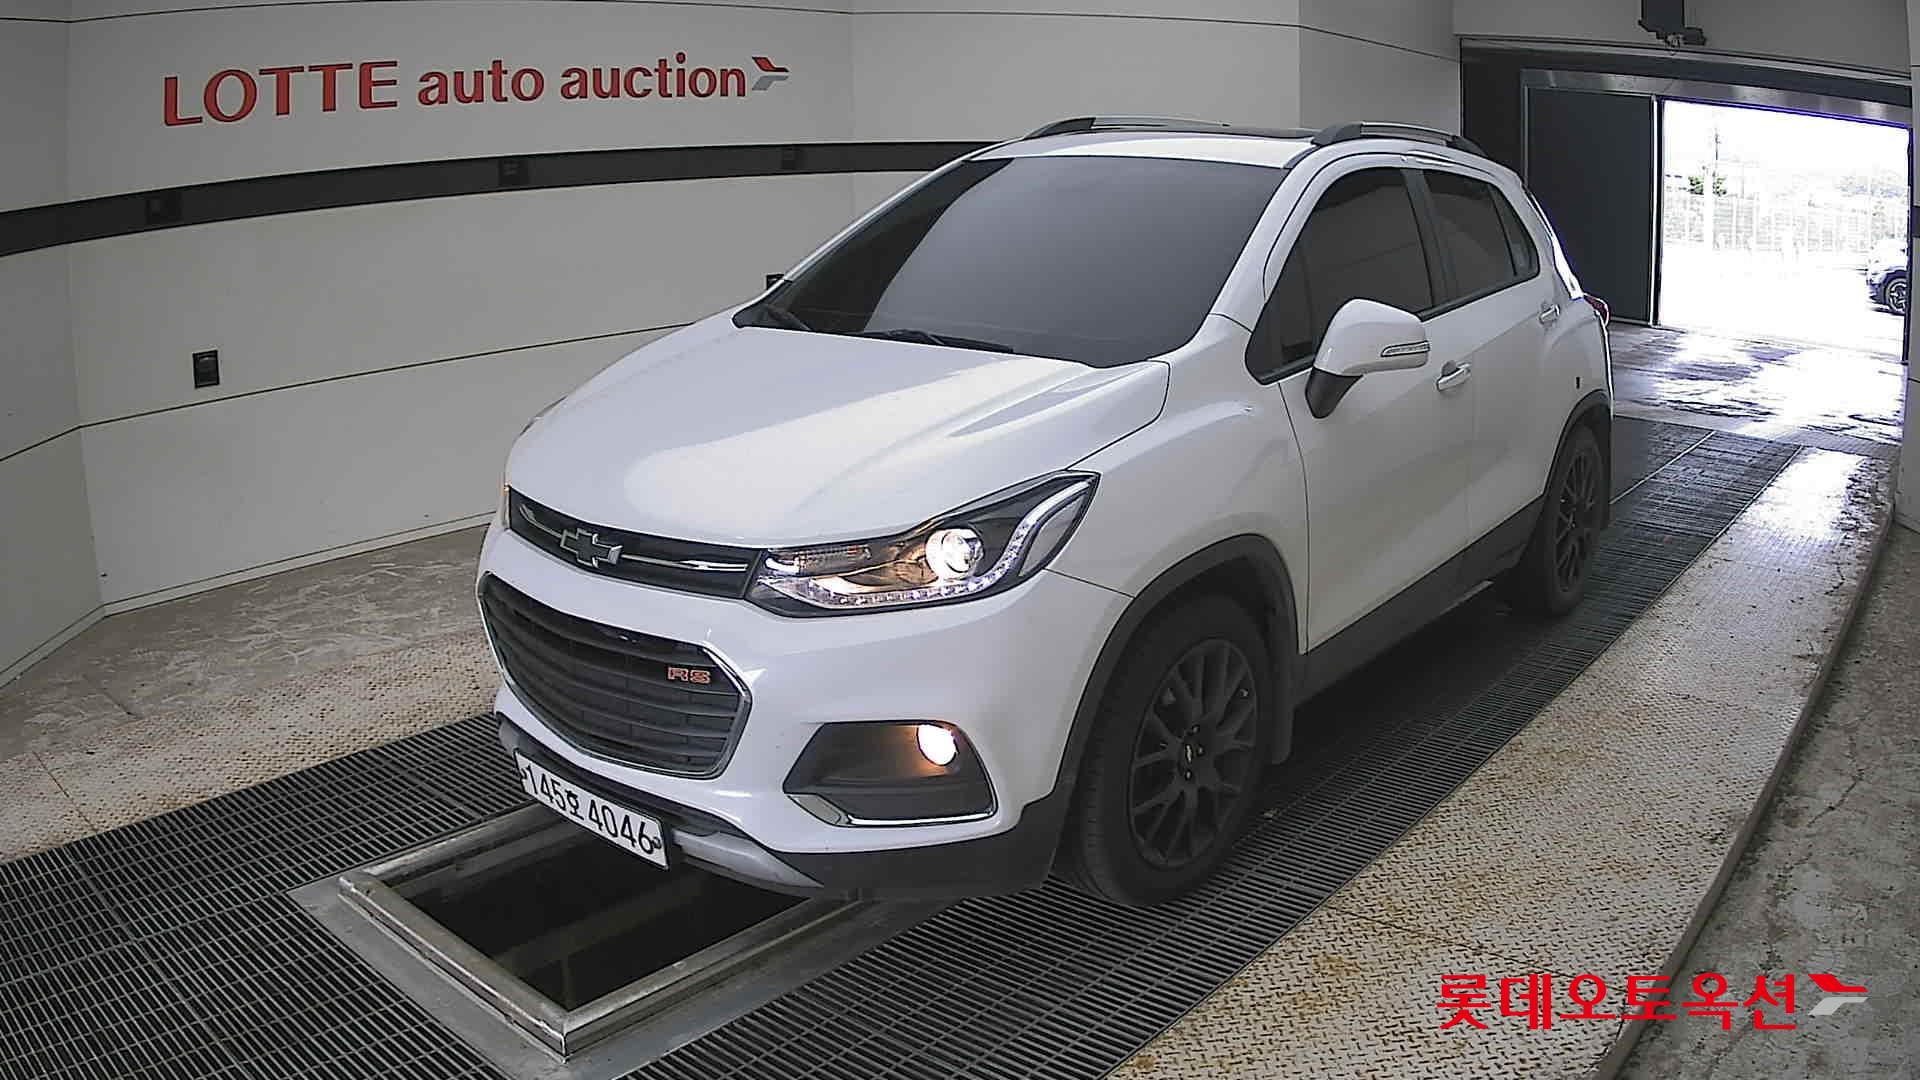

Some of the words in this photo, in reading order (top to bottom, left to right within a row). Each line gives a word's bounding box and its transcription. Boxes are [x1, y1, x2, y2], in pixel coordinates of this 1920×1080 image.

[163, 60, 399, 127] LOTTE
[417, 59, 545, 106] auto
[560, 51, 747, 99] auction
[666, 666, 712, 685] RS
